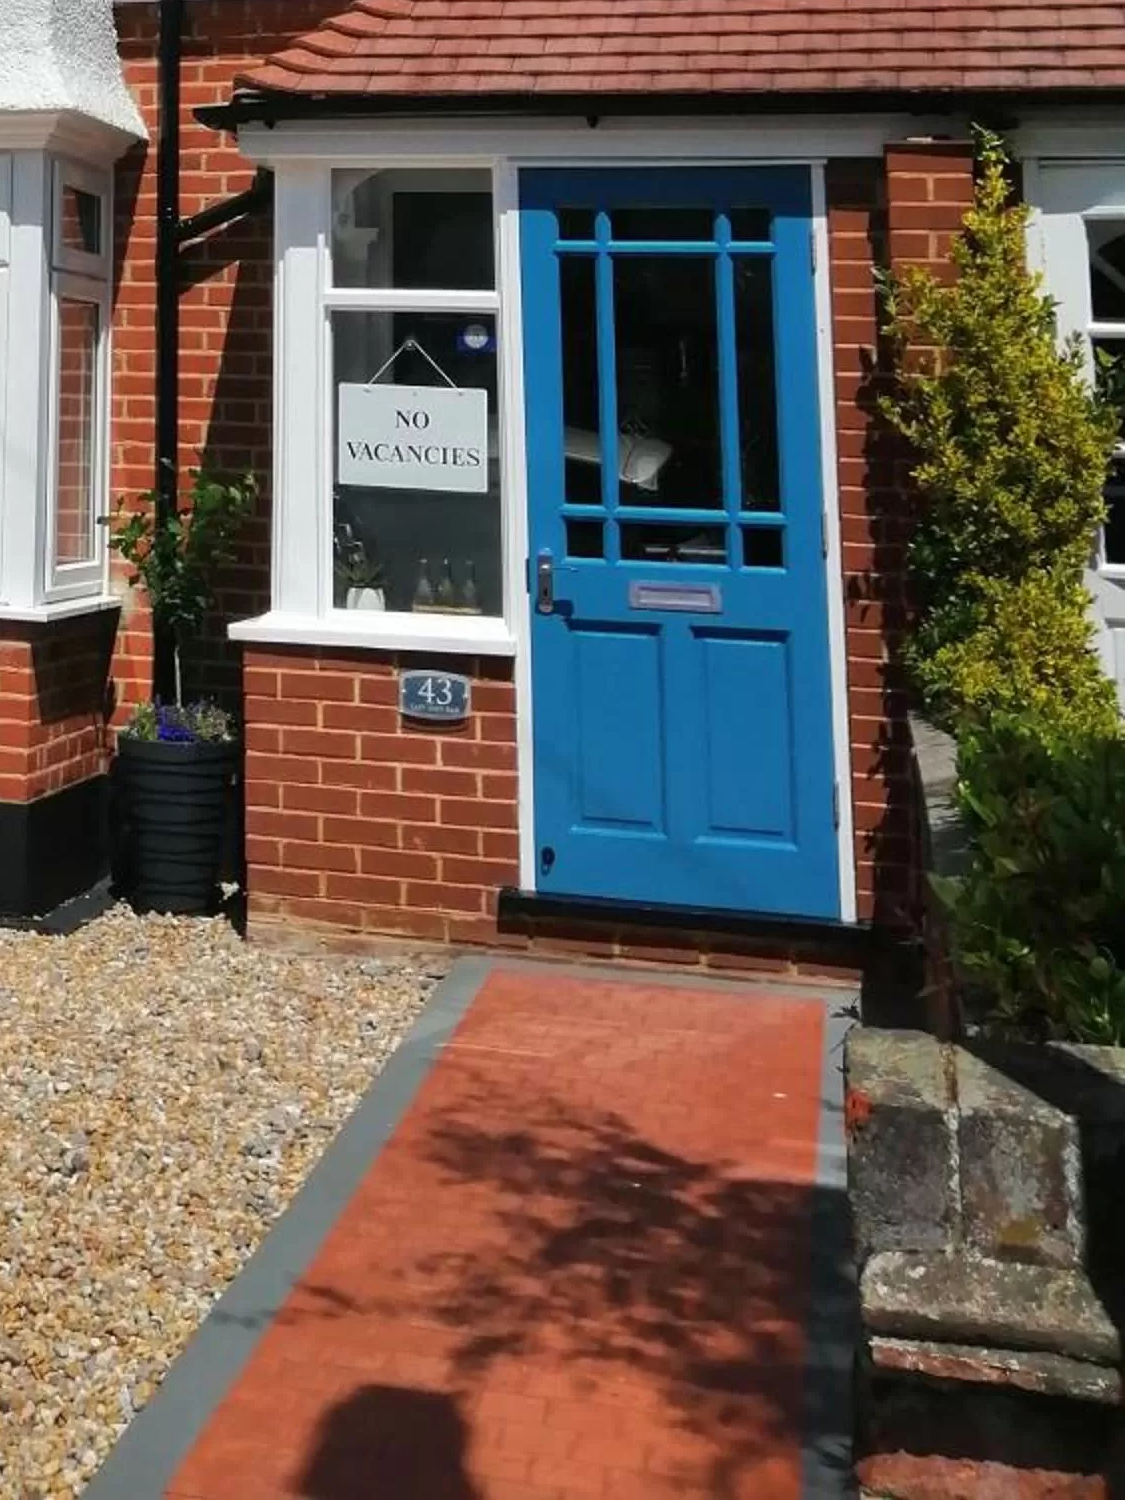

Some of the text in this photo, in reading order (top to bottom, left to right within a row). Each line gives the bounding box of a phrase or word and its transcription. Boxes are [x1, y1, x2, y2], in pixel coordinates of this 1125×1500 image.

[395, 410, 430, 430] NO
[346, 441, 481, 468] VACANCIES
[417, 677, 453, 706] 43
